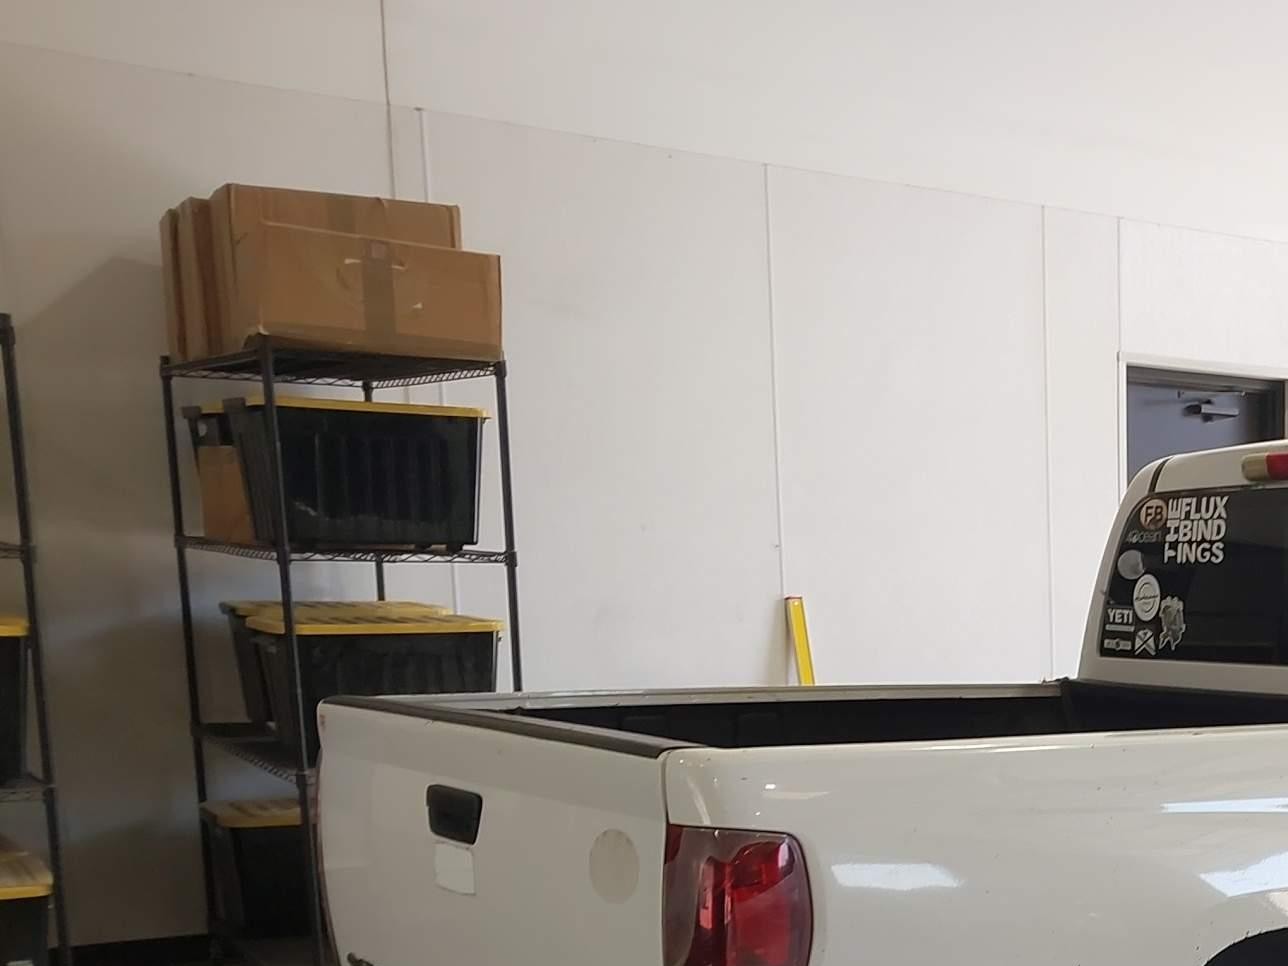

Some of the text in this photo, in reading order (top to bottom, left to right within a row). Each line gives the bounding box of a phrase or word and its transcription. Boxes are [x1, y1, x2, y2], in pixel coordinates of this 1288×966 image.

[1180, 495, 1230, 520] FLUX
[1178, 518, 1227, 542] BIND
[1108, 608, 1133, 623] YETI
